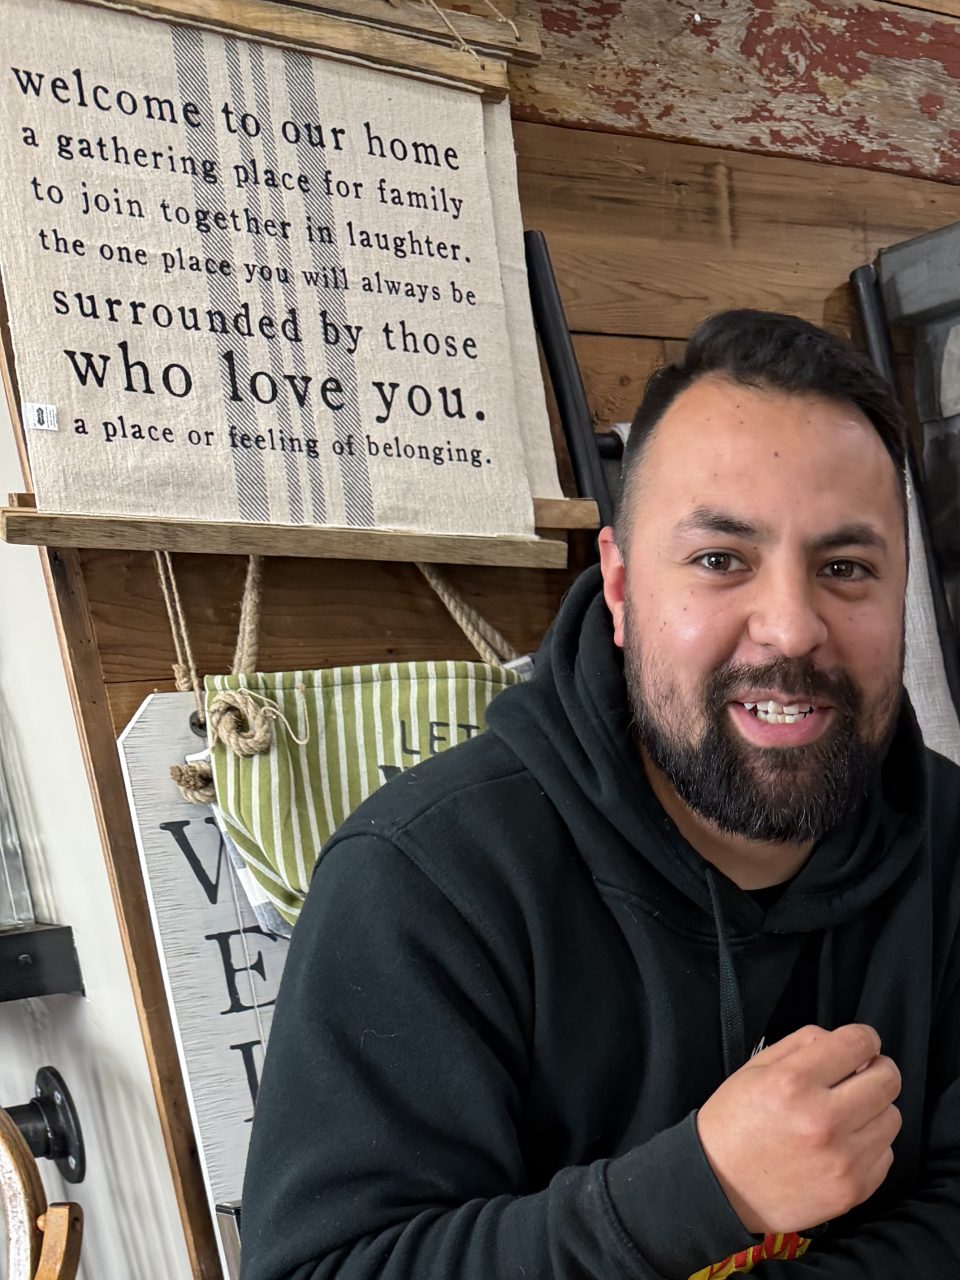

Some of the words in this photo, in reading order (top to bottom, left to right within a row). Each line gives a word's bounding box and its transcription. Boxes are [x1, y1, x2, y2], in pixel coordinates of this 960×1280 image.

[10, 67, 202, 128] welcome
[221, 102, 261, 137] to
[281, 120, 345, 150] our
[363, 121, 460, 170] home
[21, 126, 39, 147] a
[57, 134, 218, 184] gathering
[233, 158, 310, 193] place
[323, 170, 363, 199] for
[377, 178, 463, 219] family
[31, 176, 64, 204] to
[81, 181, 145, 218] join
[160, 199, 291, 239] together
[306, 216, 334, 244] in
[347, 221, 471, 263] laughter.
[39, 229, 86, 256] the
[100, 244, 148, 266] one
[162, 247, 232, 276] place
[243, 262, 290, 284] you
[301, 266, 350, 291] will
[361, 271, 441, 303] always
[450, 281, 477, 306] be
[52, 289, 302, 343] surrounded
[319, 310, 363, 354] by
[382, 320, 478, 359] those
[63, 340, 193, 398] who
[221, 350, 345, 411] love
[372, 381, 486, 424] you.
[74, 418, 89, 435] a
[102, 415, 175, 443] place
[187, 429, 215, 447] or
[229, 425, 319, 459] feeling
[332, 434, 354, 456] of
[365, 435, 492, 468] belonging.
